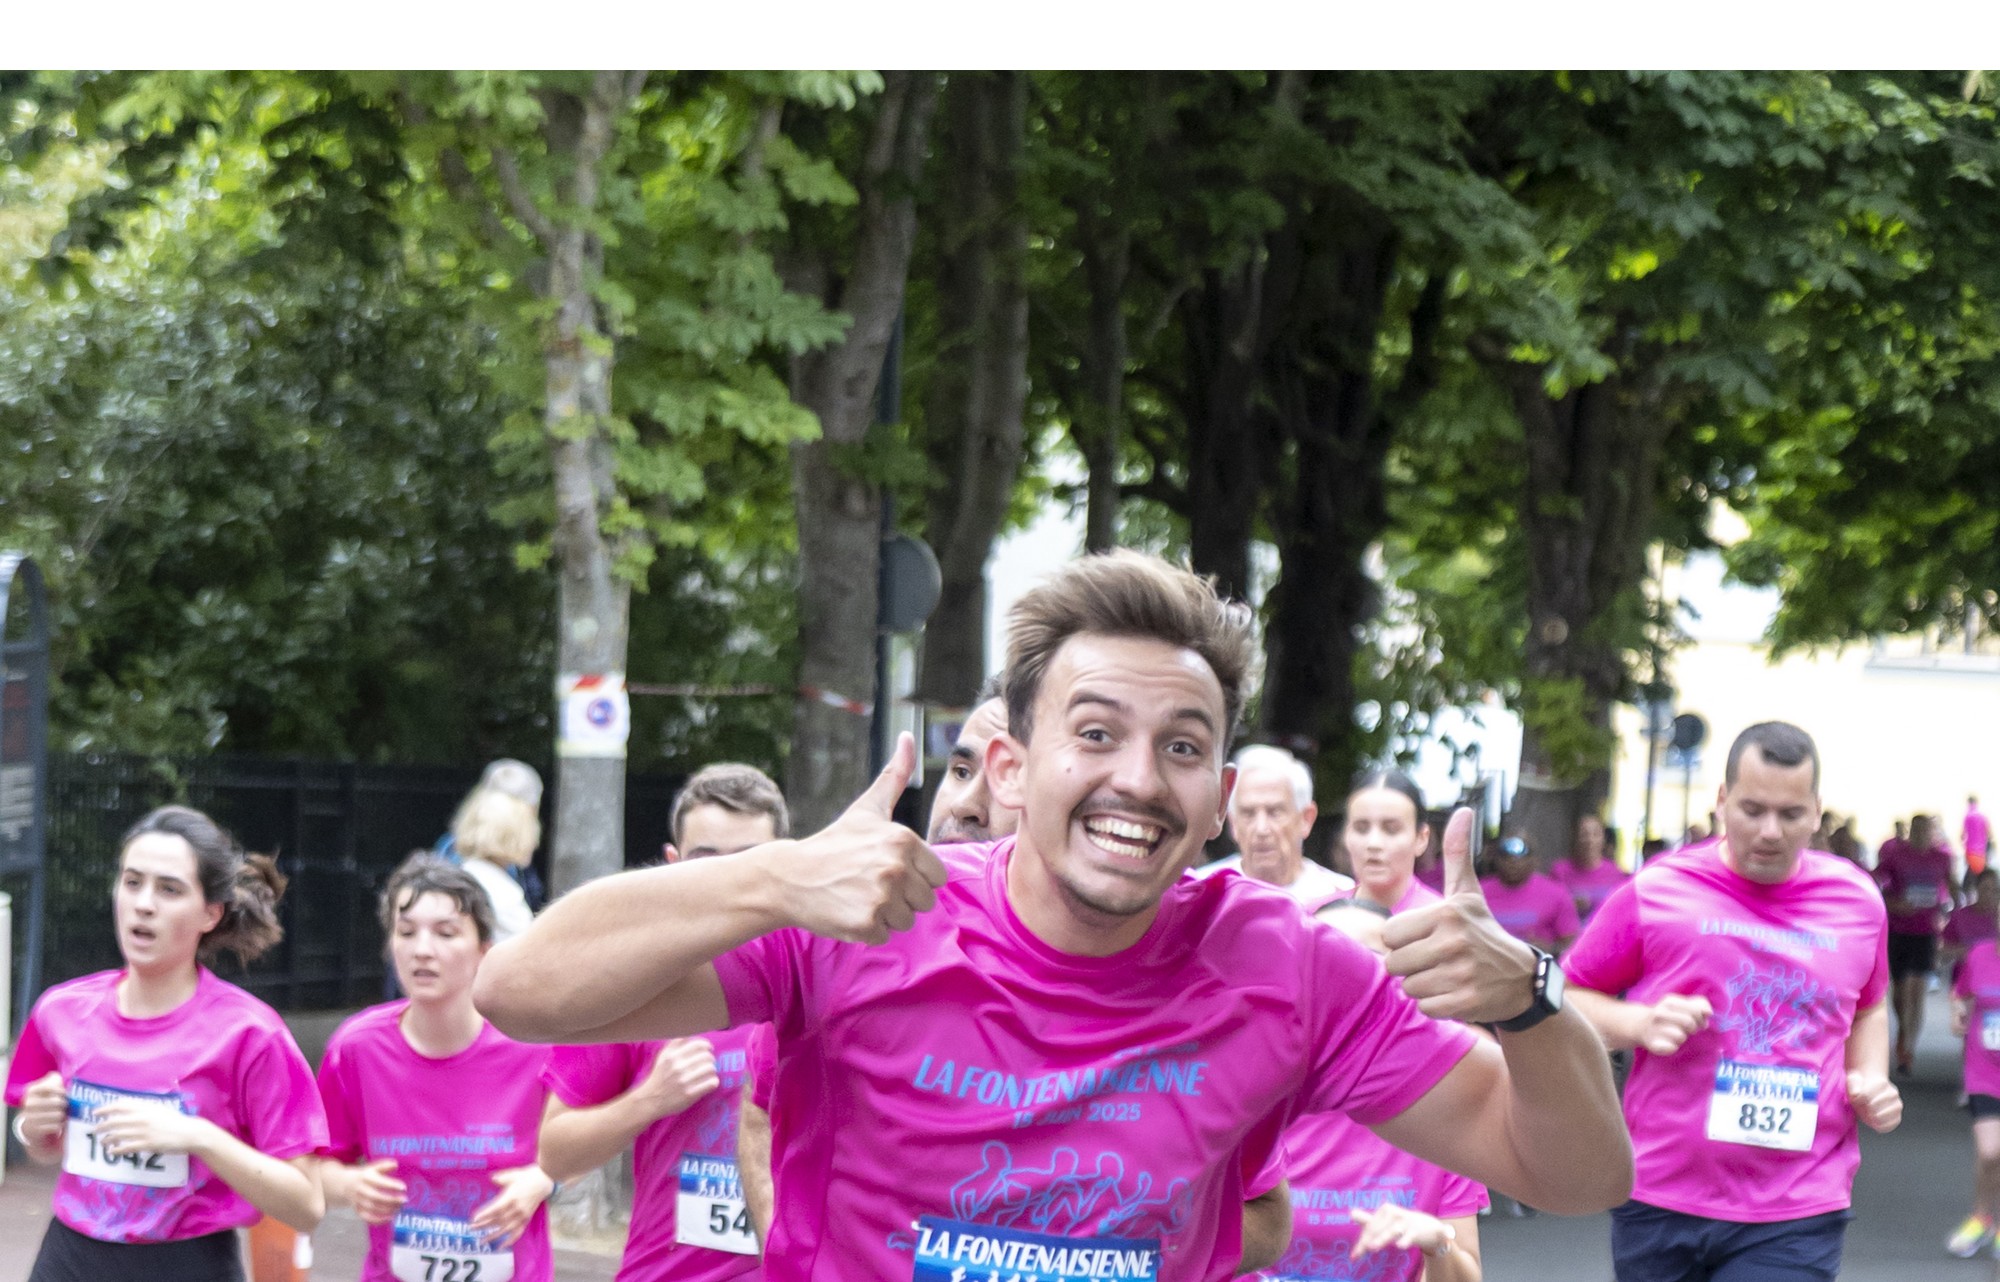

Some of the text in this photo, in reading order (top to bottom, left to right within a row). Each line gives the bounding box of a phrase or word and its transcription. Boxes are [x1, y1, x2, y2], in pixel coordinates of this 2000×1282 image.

[914, 1053, 1209, 1110] LA FONTENAISIENNE
[1717, 1062, 1734, 1078] LA
[1086, 1102, 1142, 1122] 2025
[1738, 1103, 1793, 1135] 832
[682, 1160, 700, 1176] LA
[396, 1213, 410, 1228] LA
[917, 1228, 1156, 1279] LA FONTENAISIENNE
[420, 1254, 481, 1282] 722
